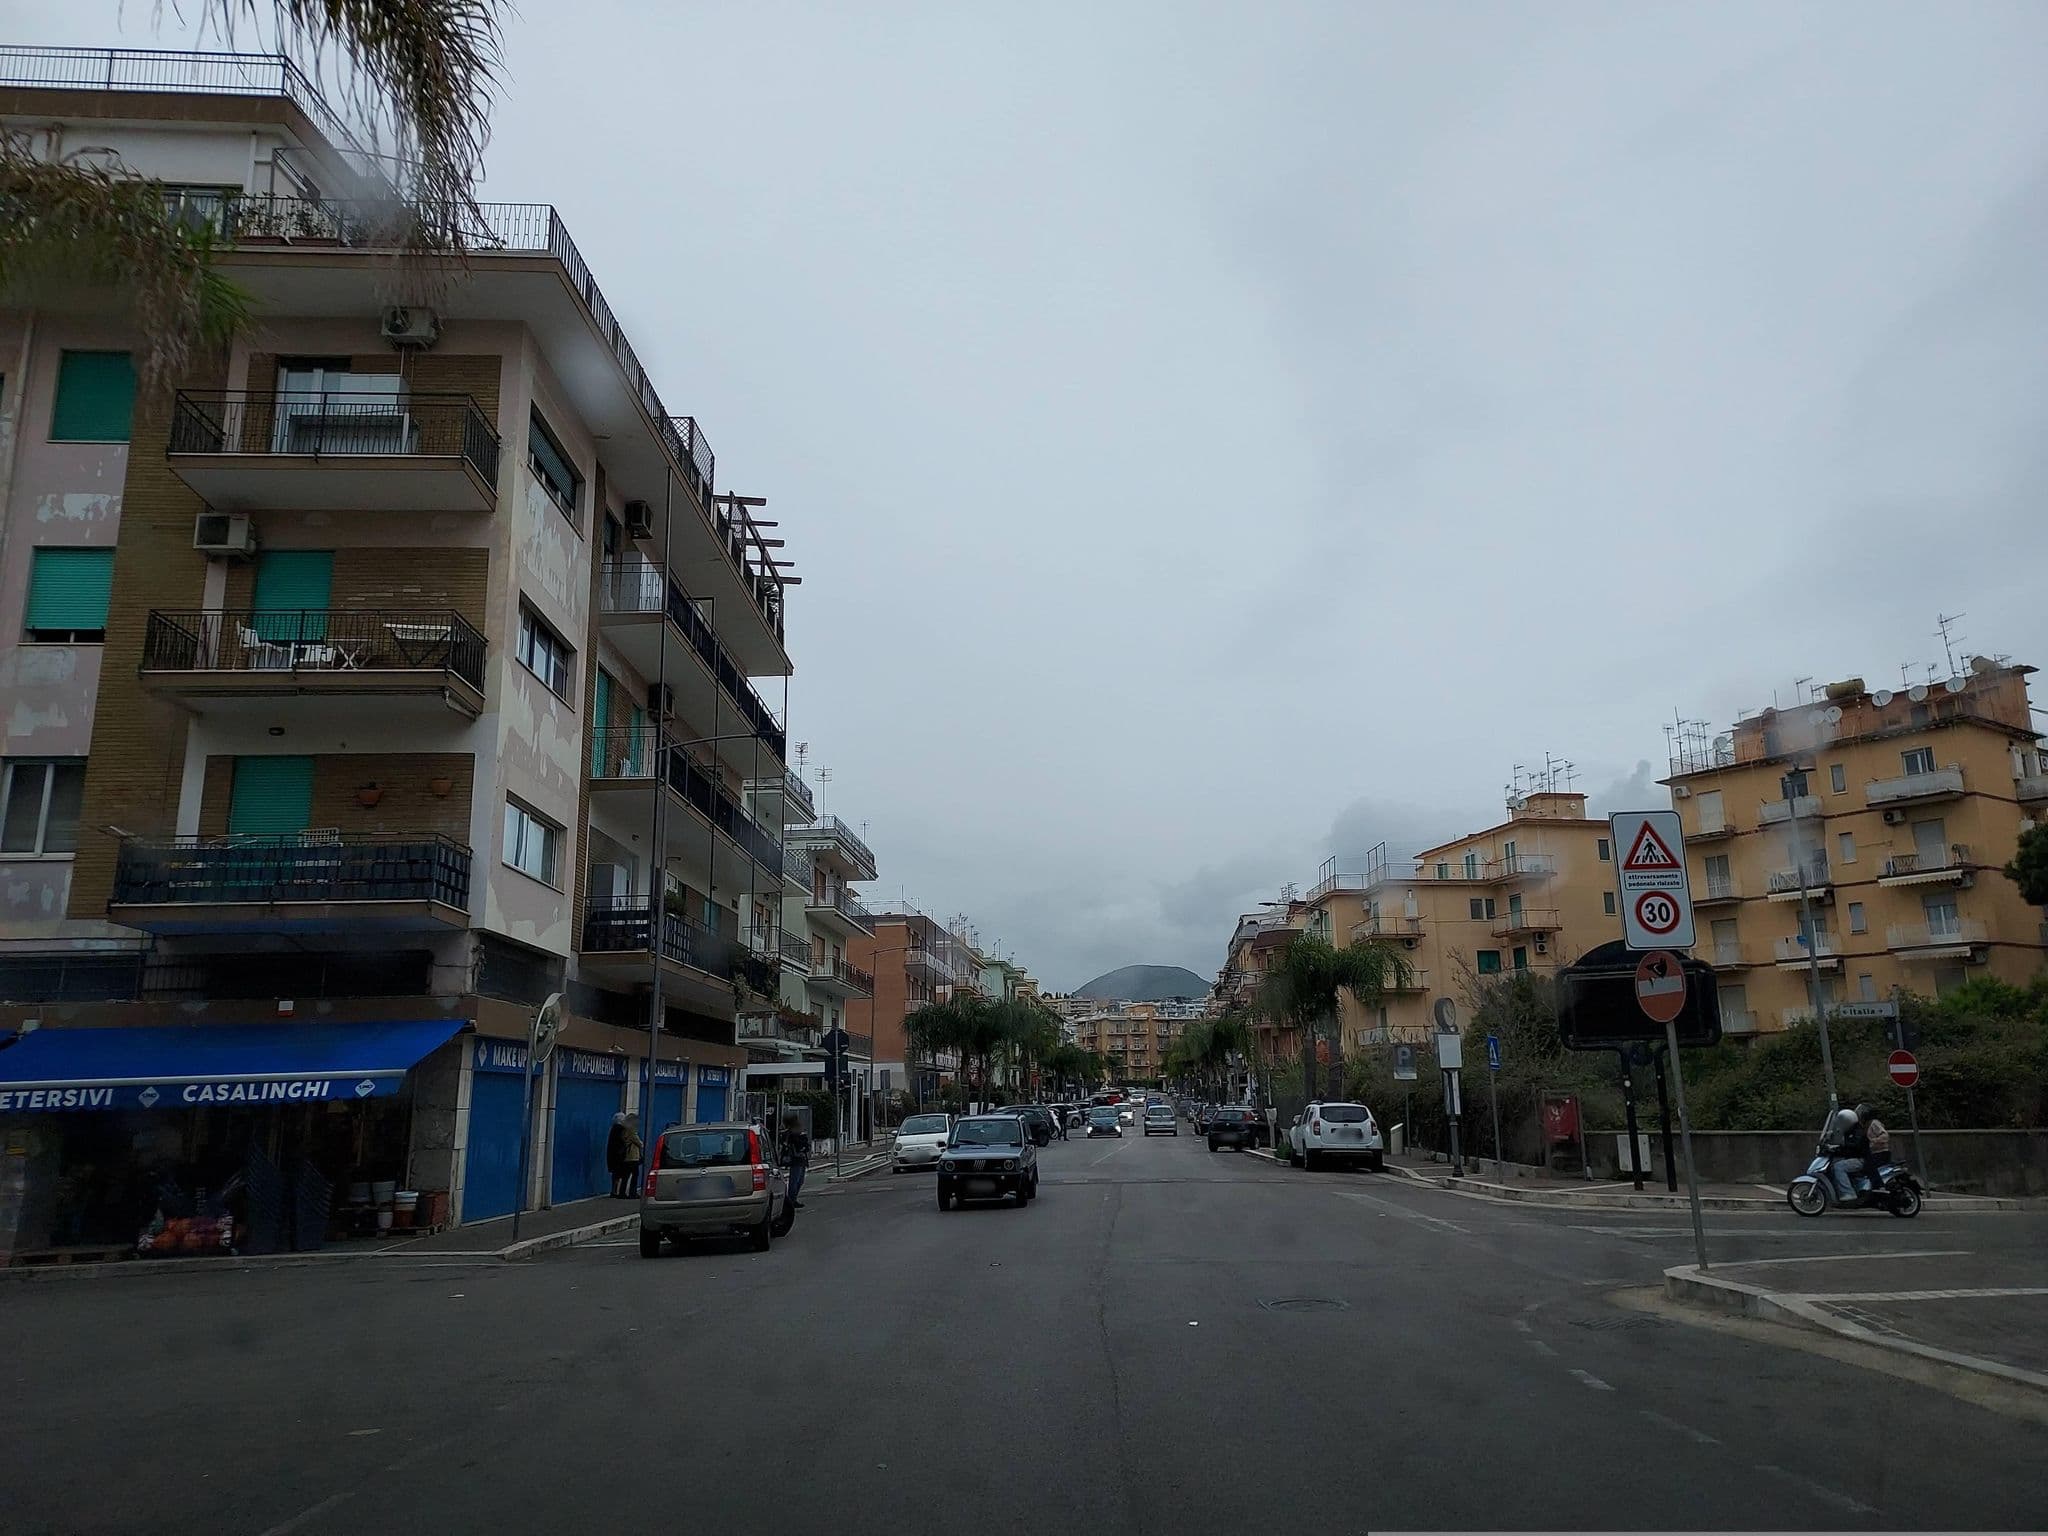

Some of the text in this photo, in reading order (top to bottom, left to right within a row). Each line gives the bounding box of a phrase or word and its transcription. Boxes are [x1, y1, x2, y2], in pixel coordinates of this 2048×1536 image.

[1644, 902, 1671, 923] 30
[492, 1045, 527, 1068] MAKE UP
[572, 1053, 615, 1076] PROFUMERIA
[0, 1088, 114, 1110] ETERSIVI
[182, 1080, 330, 1102] CASALINGHI
